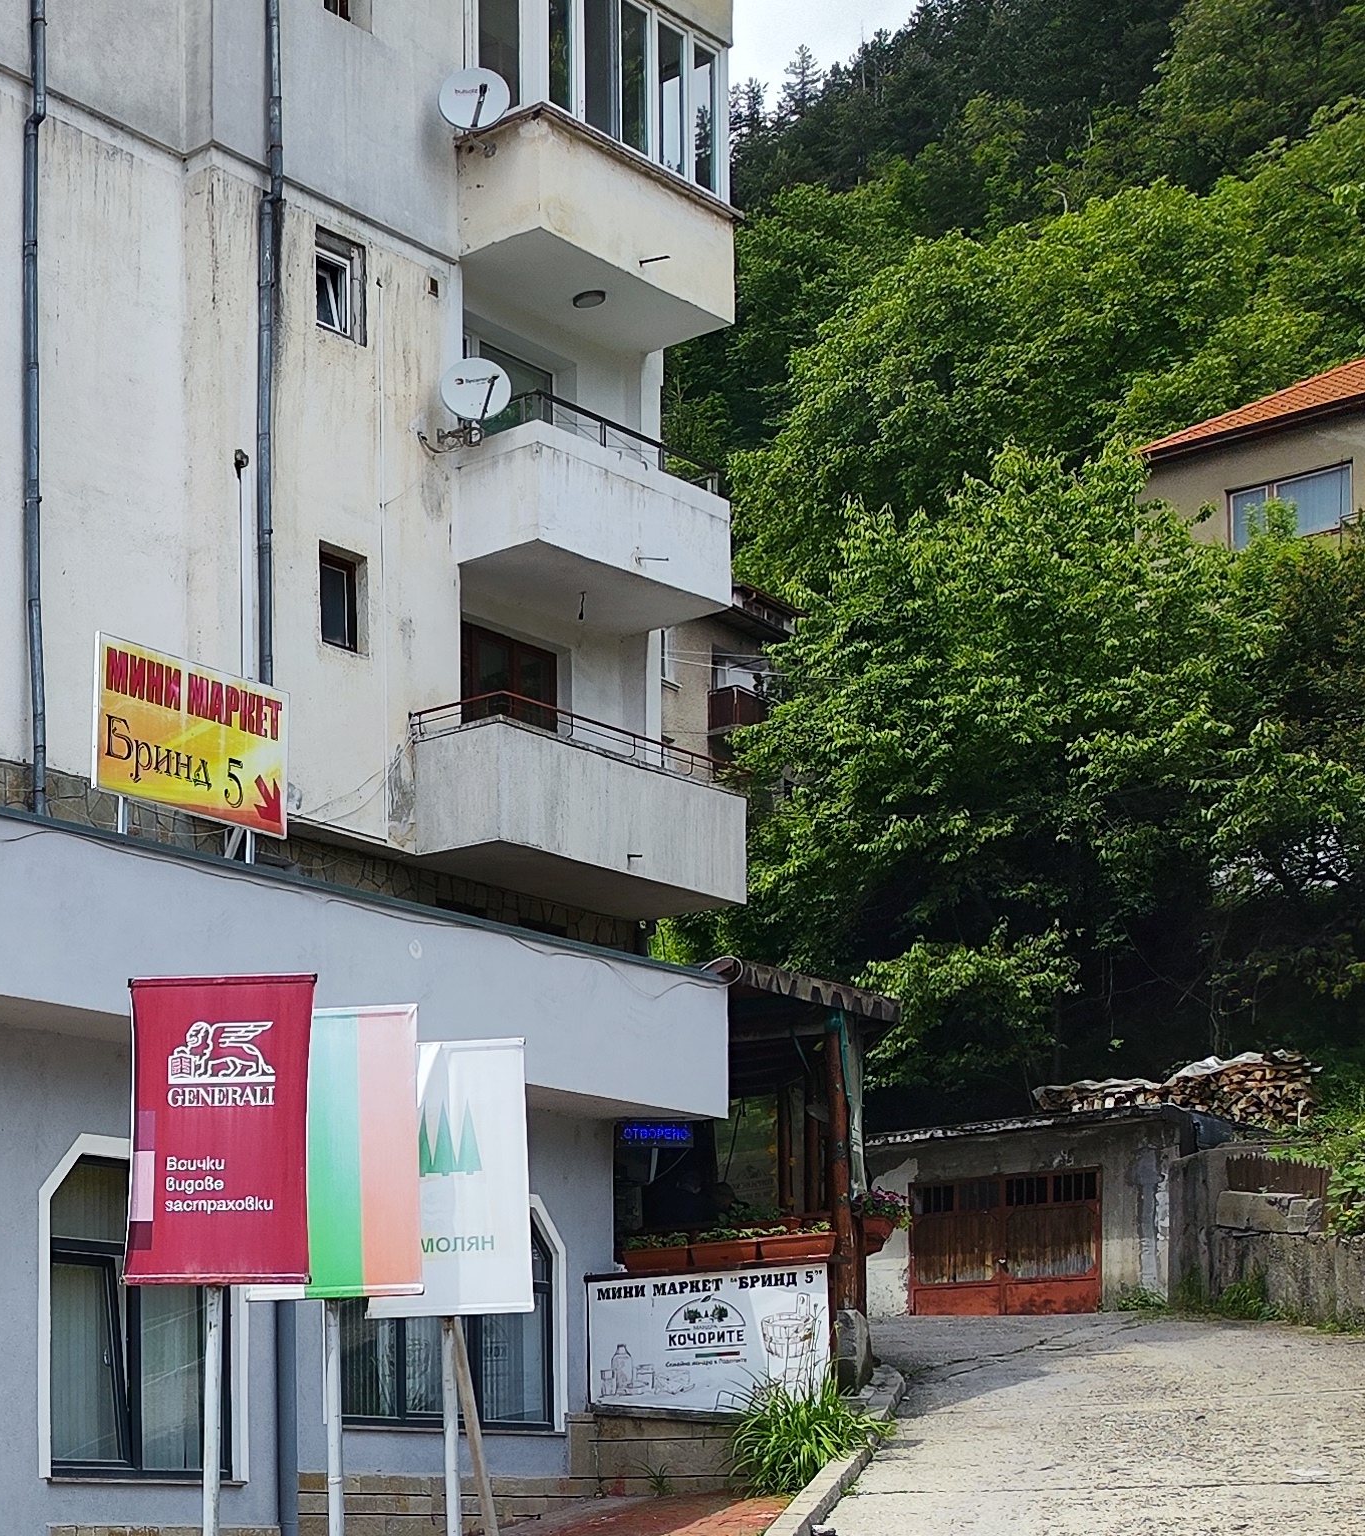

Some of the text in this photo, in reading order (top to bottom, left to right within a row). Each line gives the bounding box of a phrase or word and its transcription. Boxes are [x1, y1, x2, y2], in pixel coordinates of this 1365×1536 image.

[105, 646, 283, 741] МИНИ МАРКЕТ
[105, 713, 244, 808] Бринд 5
[167, 1085, 275, 1107] GENERALI
[624, 1128, 690, 1140] ОТВОРЕНО
[166, 1156, 225, 1171] Всички
[165, 1176, 224, 1194] видове
[165, 1196, 274, 1214] застраховки
[421, 1235, 494, 1253] МОЛЯН
[596, 1285, 646, 1301] МИНИ
[652, 1277, 723, 1298] МАРКЕТ
[669, 1329, 744, 1347] КОЧОРИТЕ
